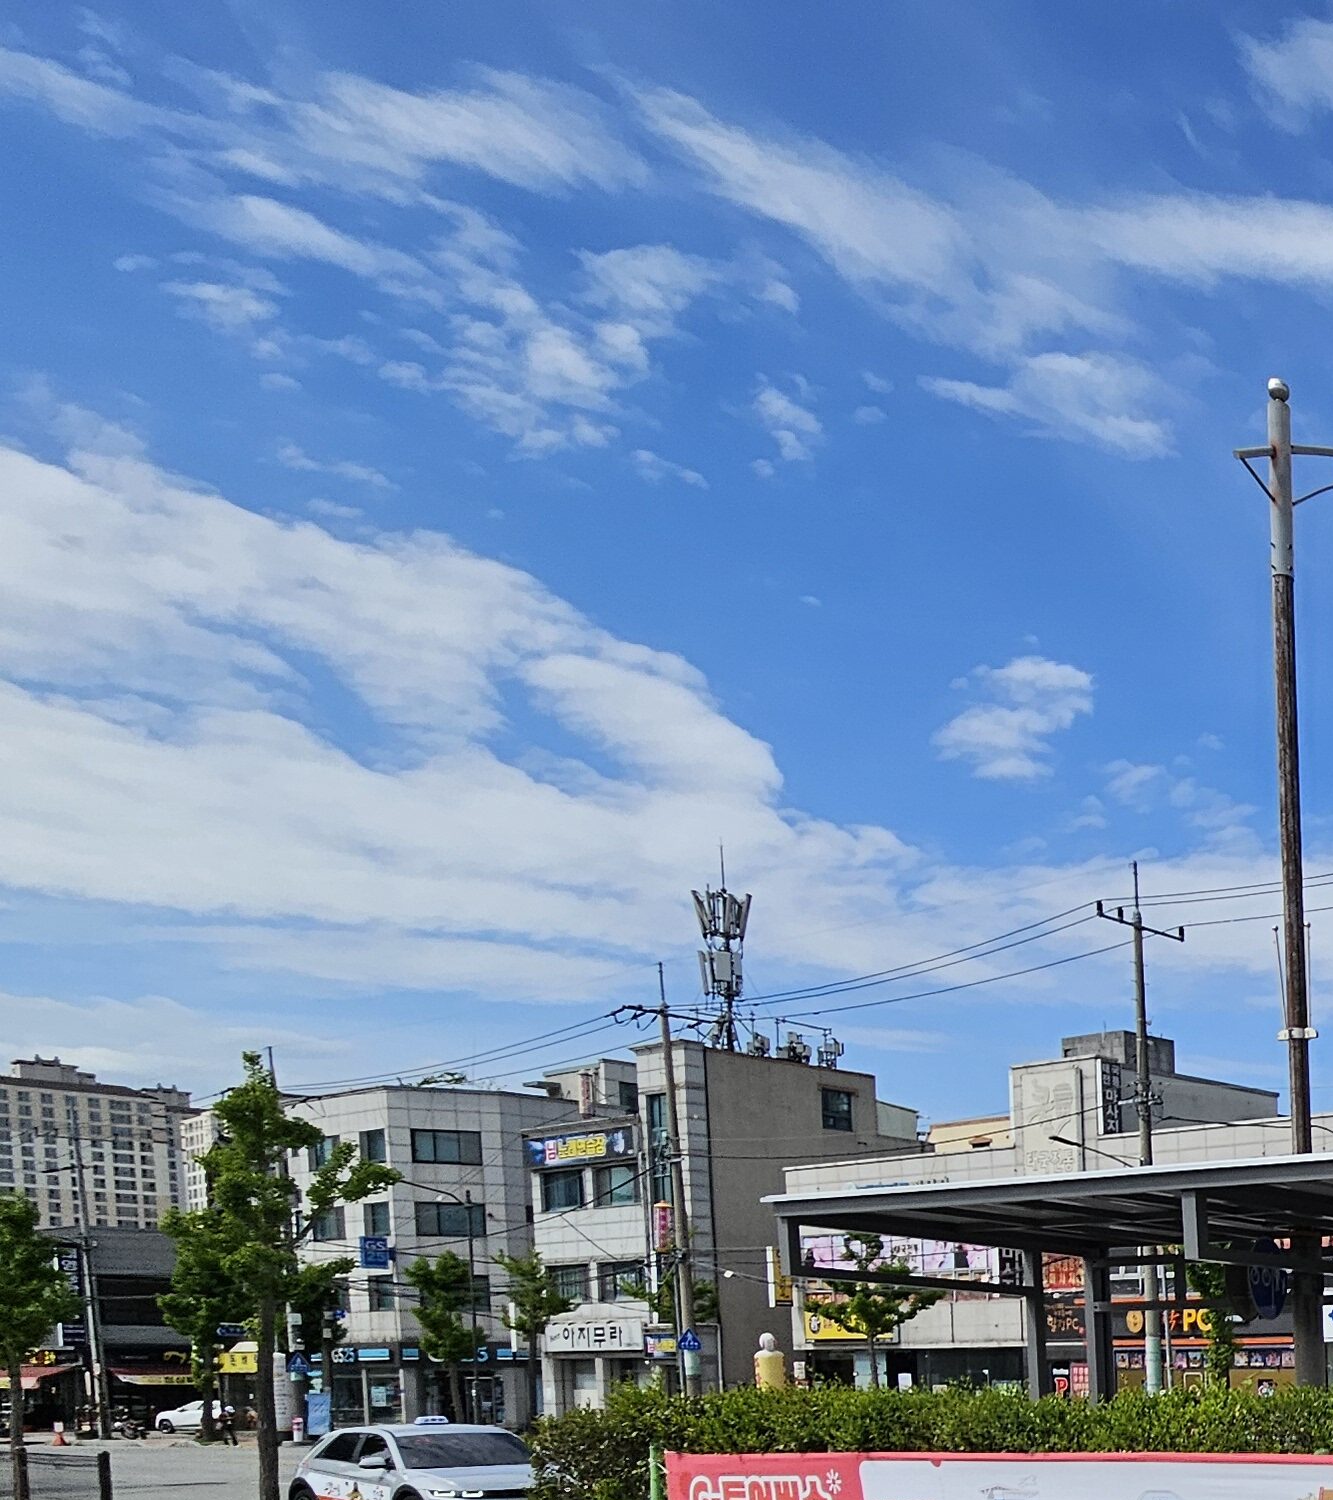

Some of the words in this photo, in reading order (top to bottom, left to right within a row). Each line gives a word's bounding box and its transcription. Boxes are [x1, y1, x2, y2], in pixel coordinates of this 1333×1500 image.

[1105, 1089, 1119, 1133] 마사지
[366, 1240, 385, 1250] GS
[367, 1251, 386, 1262] 25
[562, 1327, 623, 1347] 아지무라
